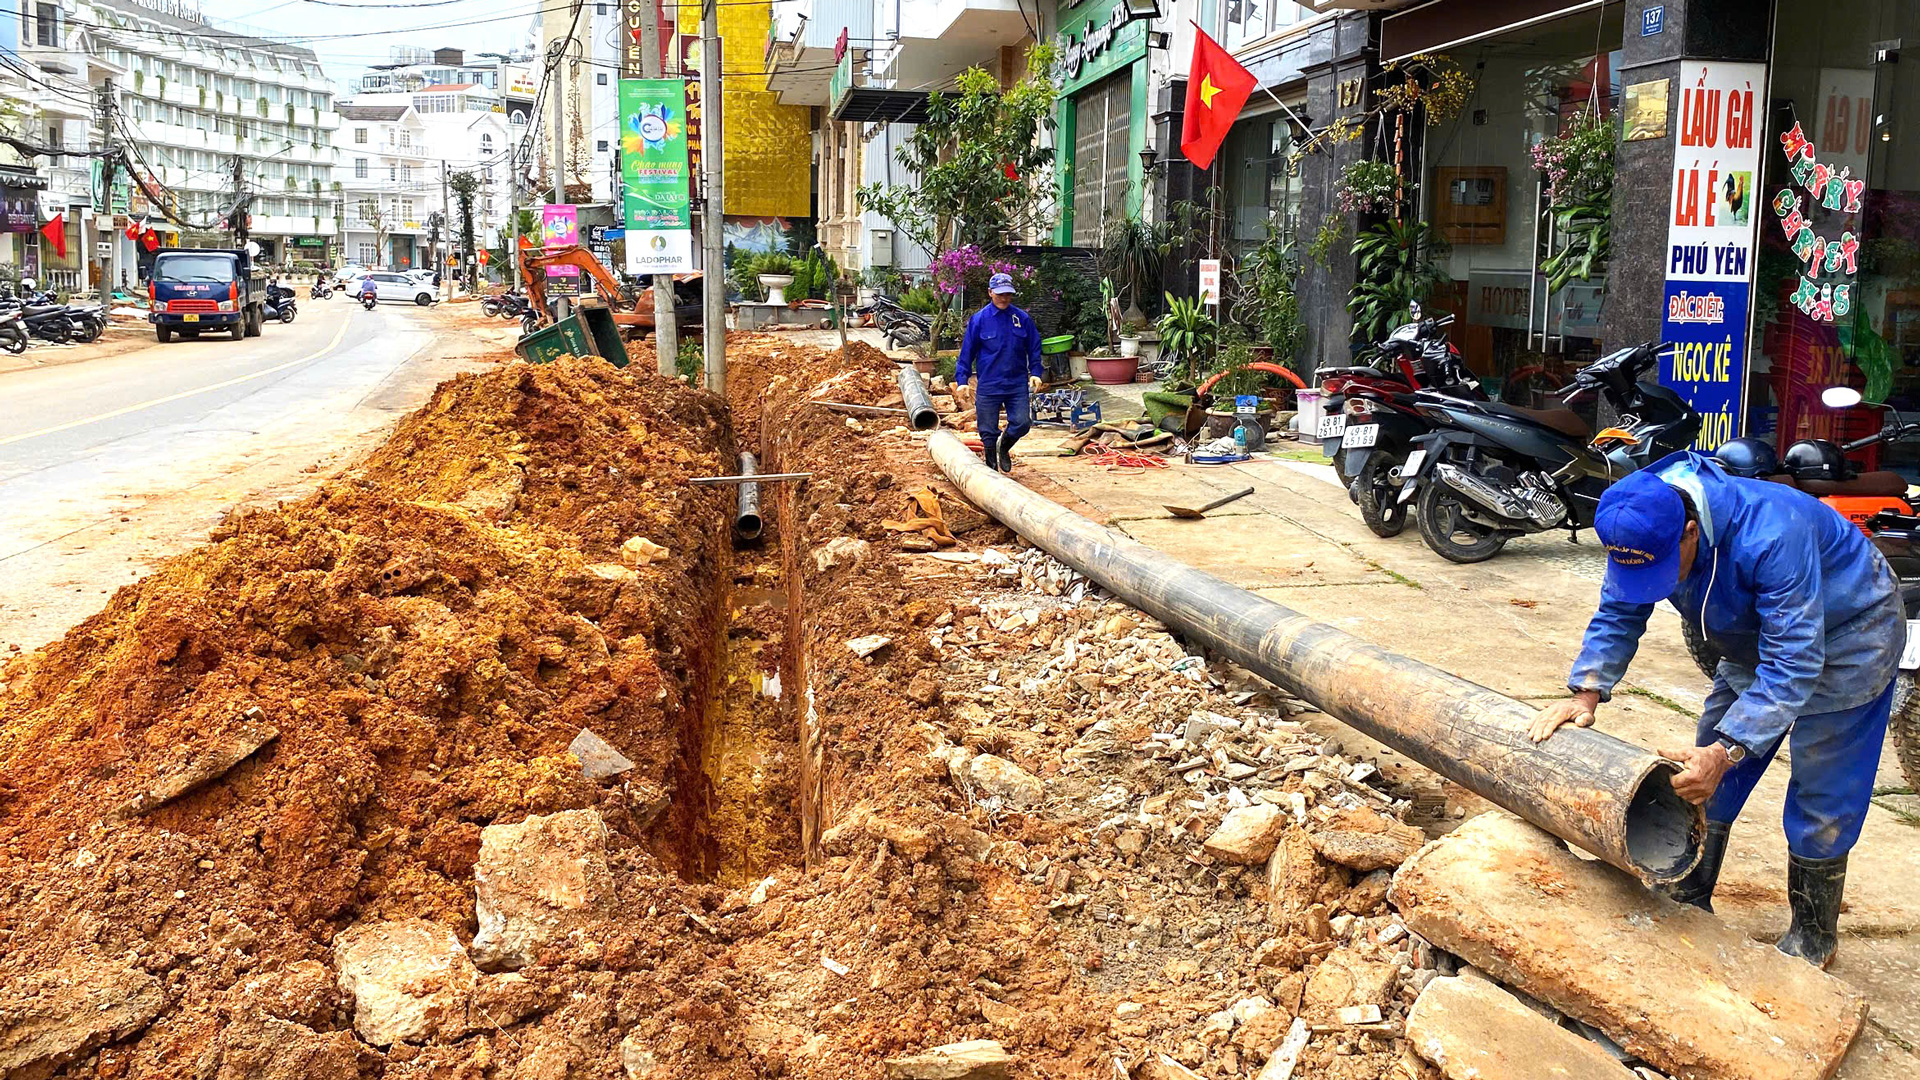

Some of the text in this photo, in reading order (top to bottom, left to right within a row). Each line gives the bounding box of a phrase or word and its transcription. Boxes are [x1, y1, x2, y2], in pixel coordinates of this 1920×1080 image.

[1645, 9, 1661, 25] 137
[1337, 77, 1362, 108] 137
[1681, 66, 1754, 149] LẨU GÀ
[1675, 159, 1718, 227] LÁ É
[1671, 240, 1748, 276] PHÚ YÊN
[1669, 291, 1695, 324] ĐẶC
[1672, 334, 1732, 393] NGỌC KÊ
[1695, 399, 1733, 452] MUỐI
